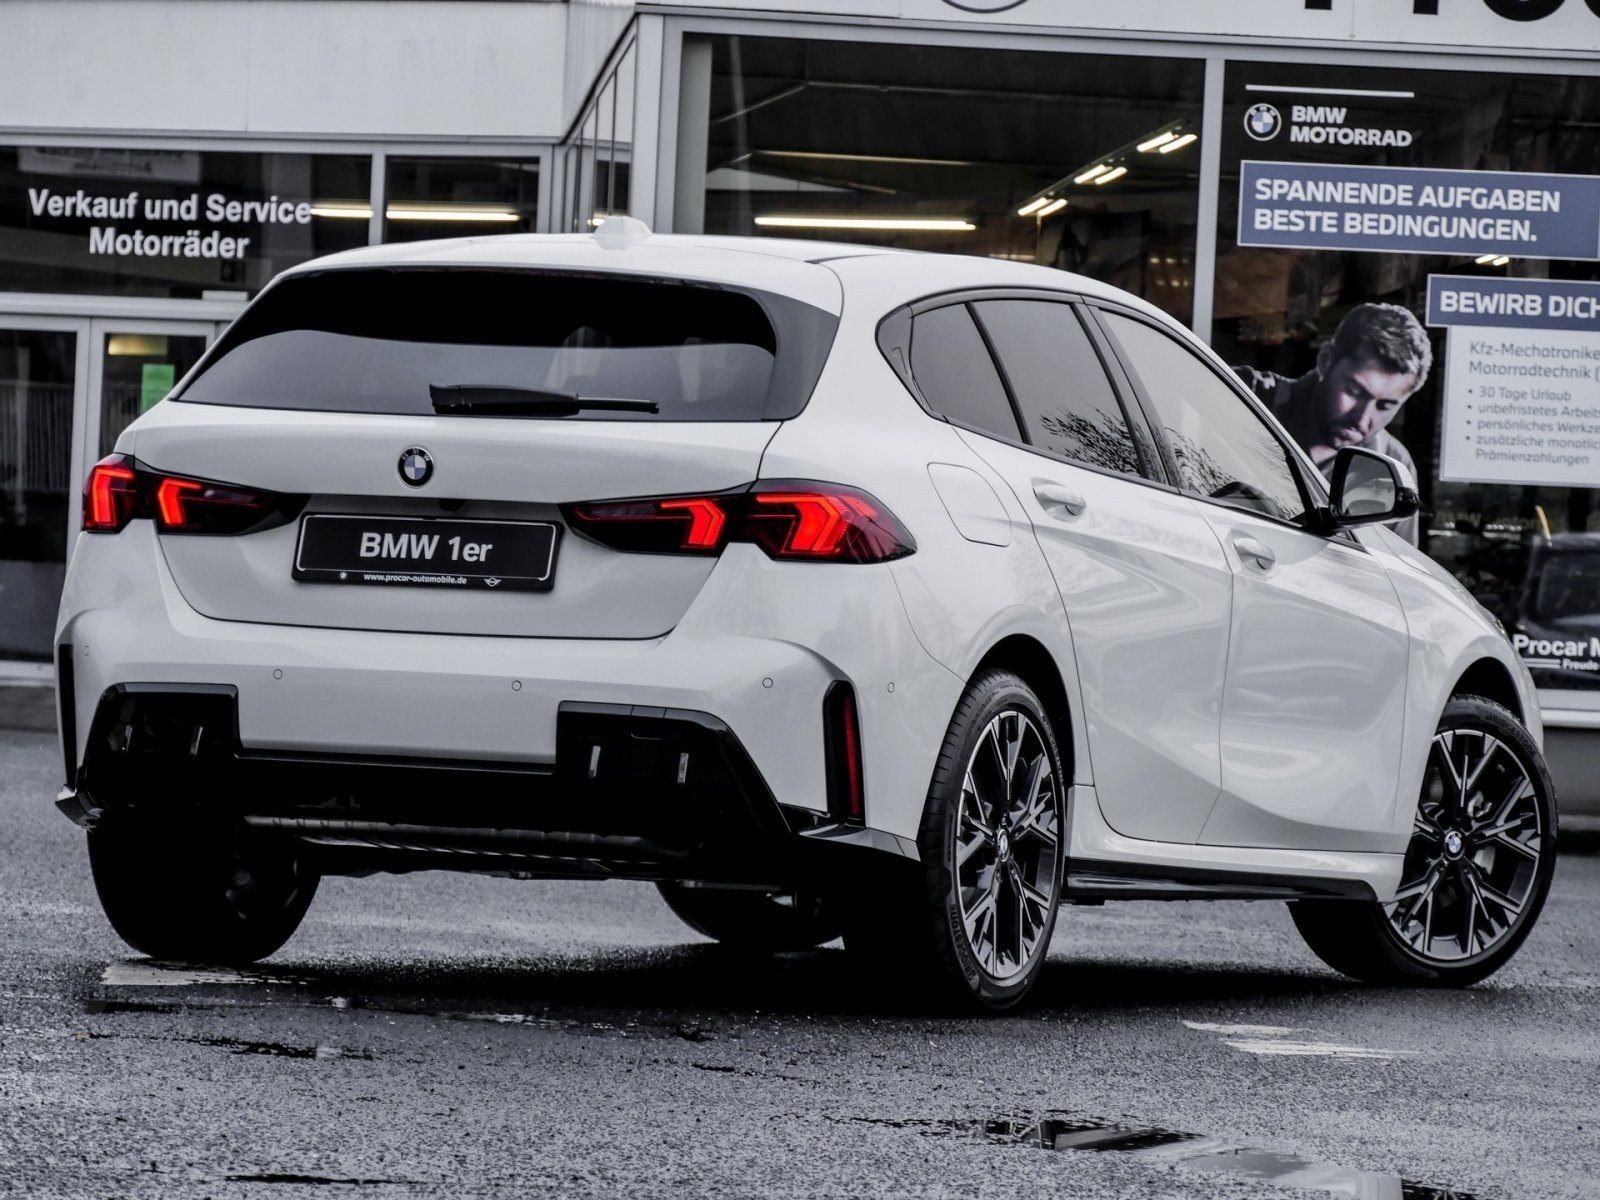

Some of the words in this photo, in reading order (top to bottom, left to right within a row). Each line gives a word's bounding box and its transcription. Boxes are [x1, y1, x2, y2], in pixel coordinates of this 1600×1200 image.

[1292, 105, 1347, 124] BMW
[1290, 126, 1413, 147] MOTORRAD
[28, 188, 139, 219] Verkauf
[144, 194, 199, 221] und
[205, 194, 312, 224] Service
[1254, 178, 1413, 206] SPANNENDE
[1418, 185, 1561, 213] AUFGABEN
[1253, 208, 1339, 234] BESTE
[1343, 212, 1538, 242] BEDINGUNGEN.
[89, 226, 250, 259] Motorräder
[1439, 290, 1543, 316] BEWIRB
[1548, 295, 1600, 319] DICH
[1469, 341, 1600, 360] Kfz-Mechatronike
[1468, 361, 1591, 379] Motorradtechnik
[1479, 386, 1496, 398] 30
[1498, 387, 1528, 401] Tage
[1531, 389, 1572, 401] Urlaub
[1478, 404, 1558, 416] unbefristetes
[1477, 419, 1554, 432] persönliches
[359, 532, 440, 560] BMW
[448, 536, 493, 562] 1er
[363, 573, 468, 585] www.procar-automobile.de
[1512, 633, 1588, 657] Procar
